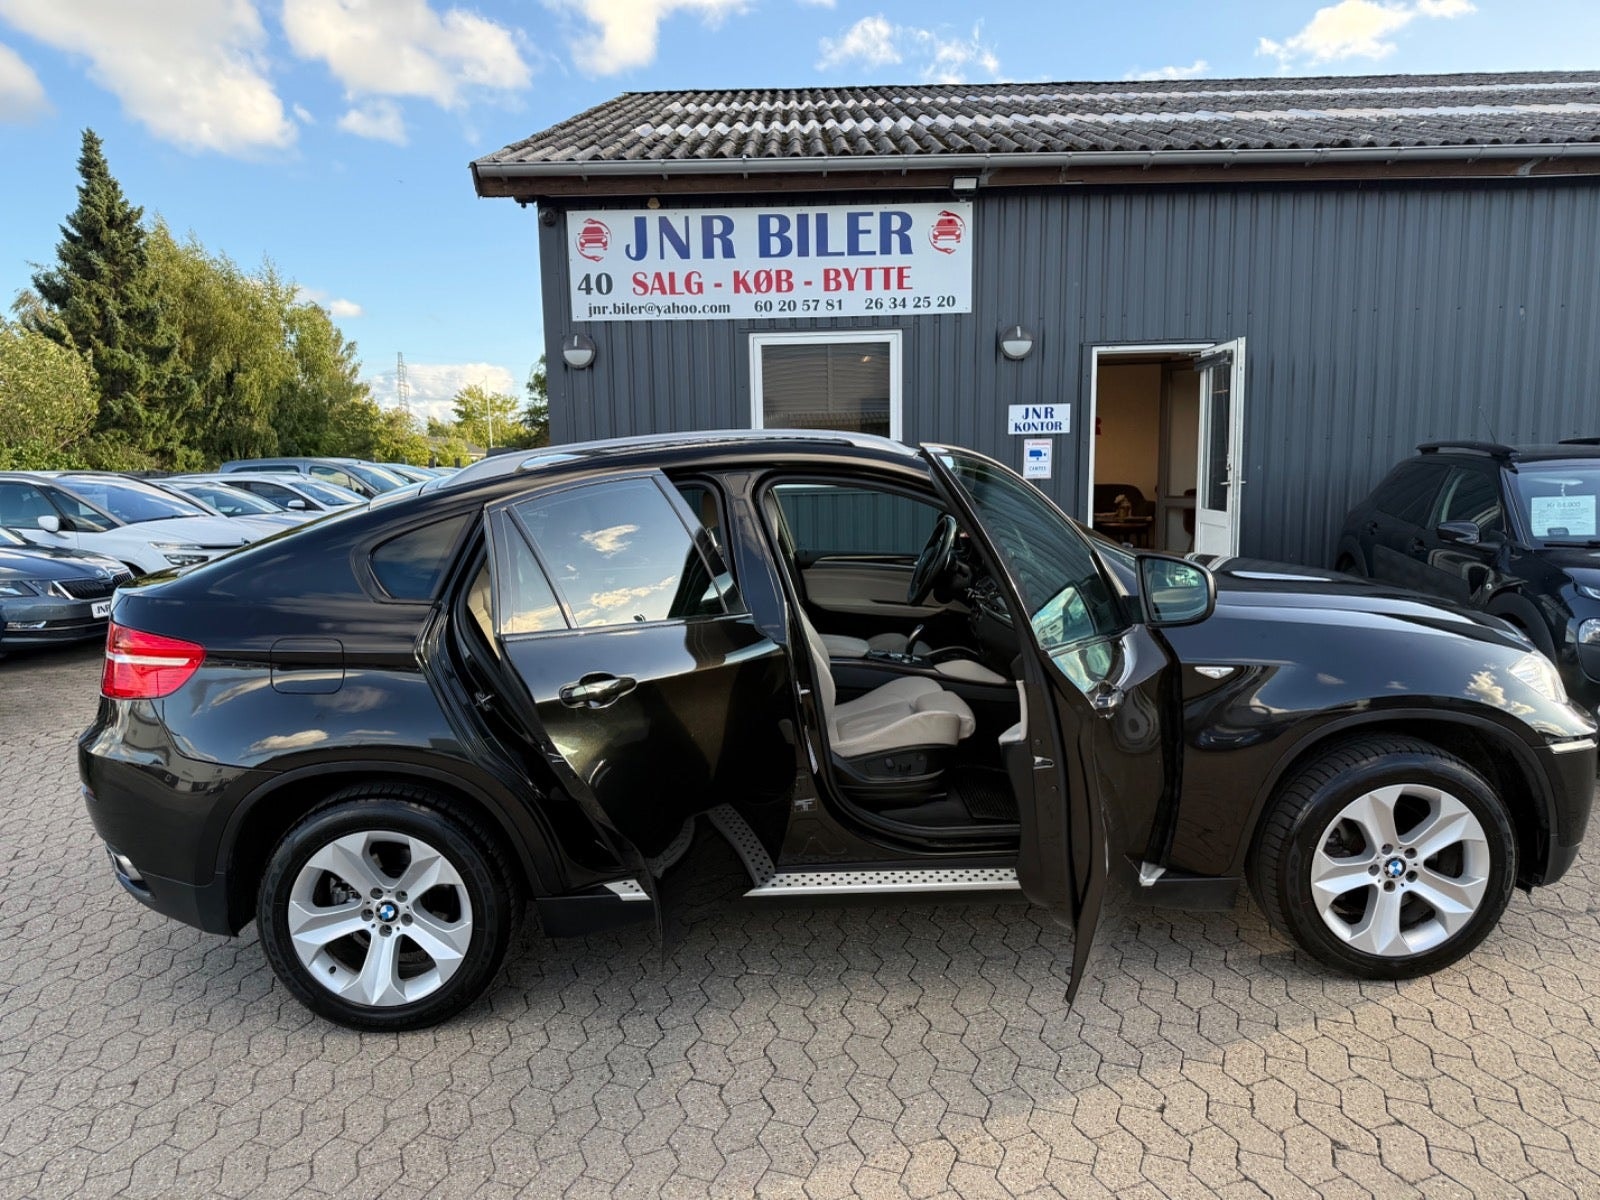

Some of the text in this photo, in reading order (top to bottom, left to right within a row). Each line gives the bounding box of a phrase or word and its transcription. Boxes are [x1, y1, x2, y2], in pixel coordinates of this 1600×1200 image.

[625, 211, 913, 261] JNR BILER
[578, 273, 613, 295] 40
[633, 271, 703, 295] SALG
[734, 269, 793, 294] KØB
[824, 267, 912, 291] BYTTE
[589, 303, 730, 317] jnr.biler@yahoo.com
[754, 298, 843, 313] 60 20 57 81
[864, 295, 956, 310] 26 34 25 20
[1022, 407, 1054, 420] JNR
[1014, 421, 1062, 432] KONTOR
